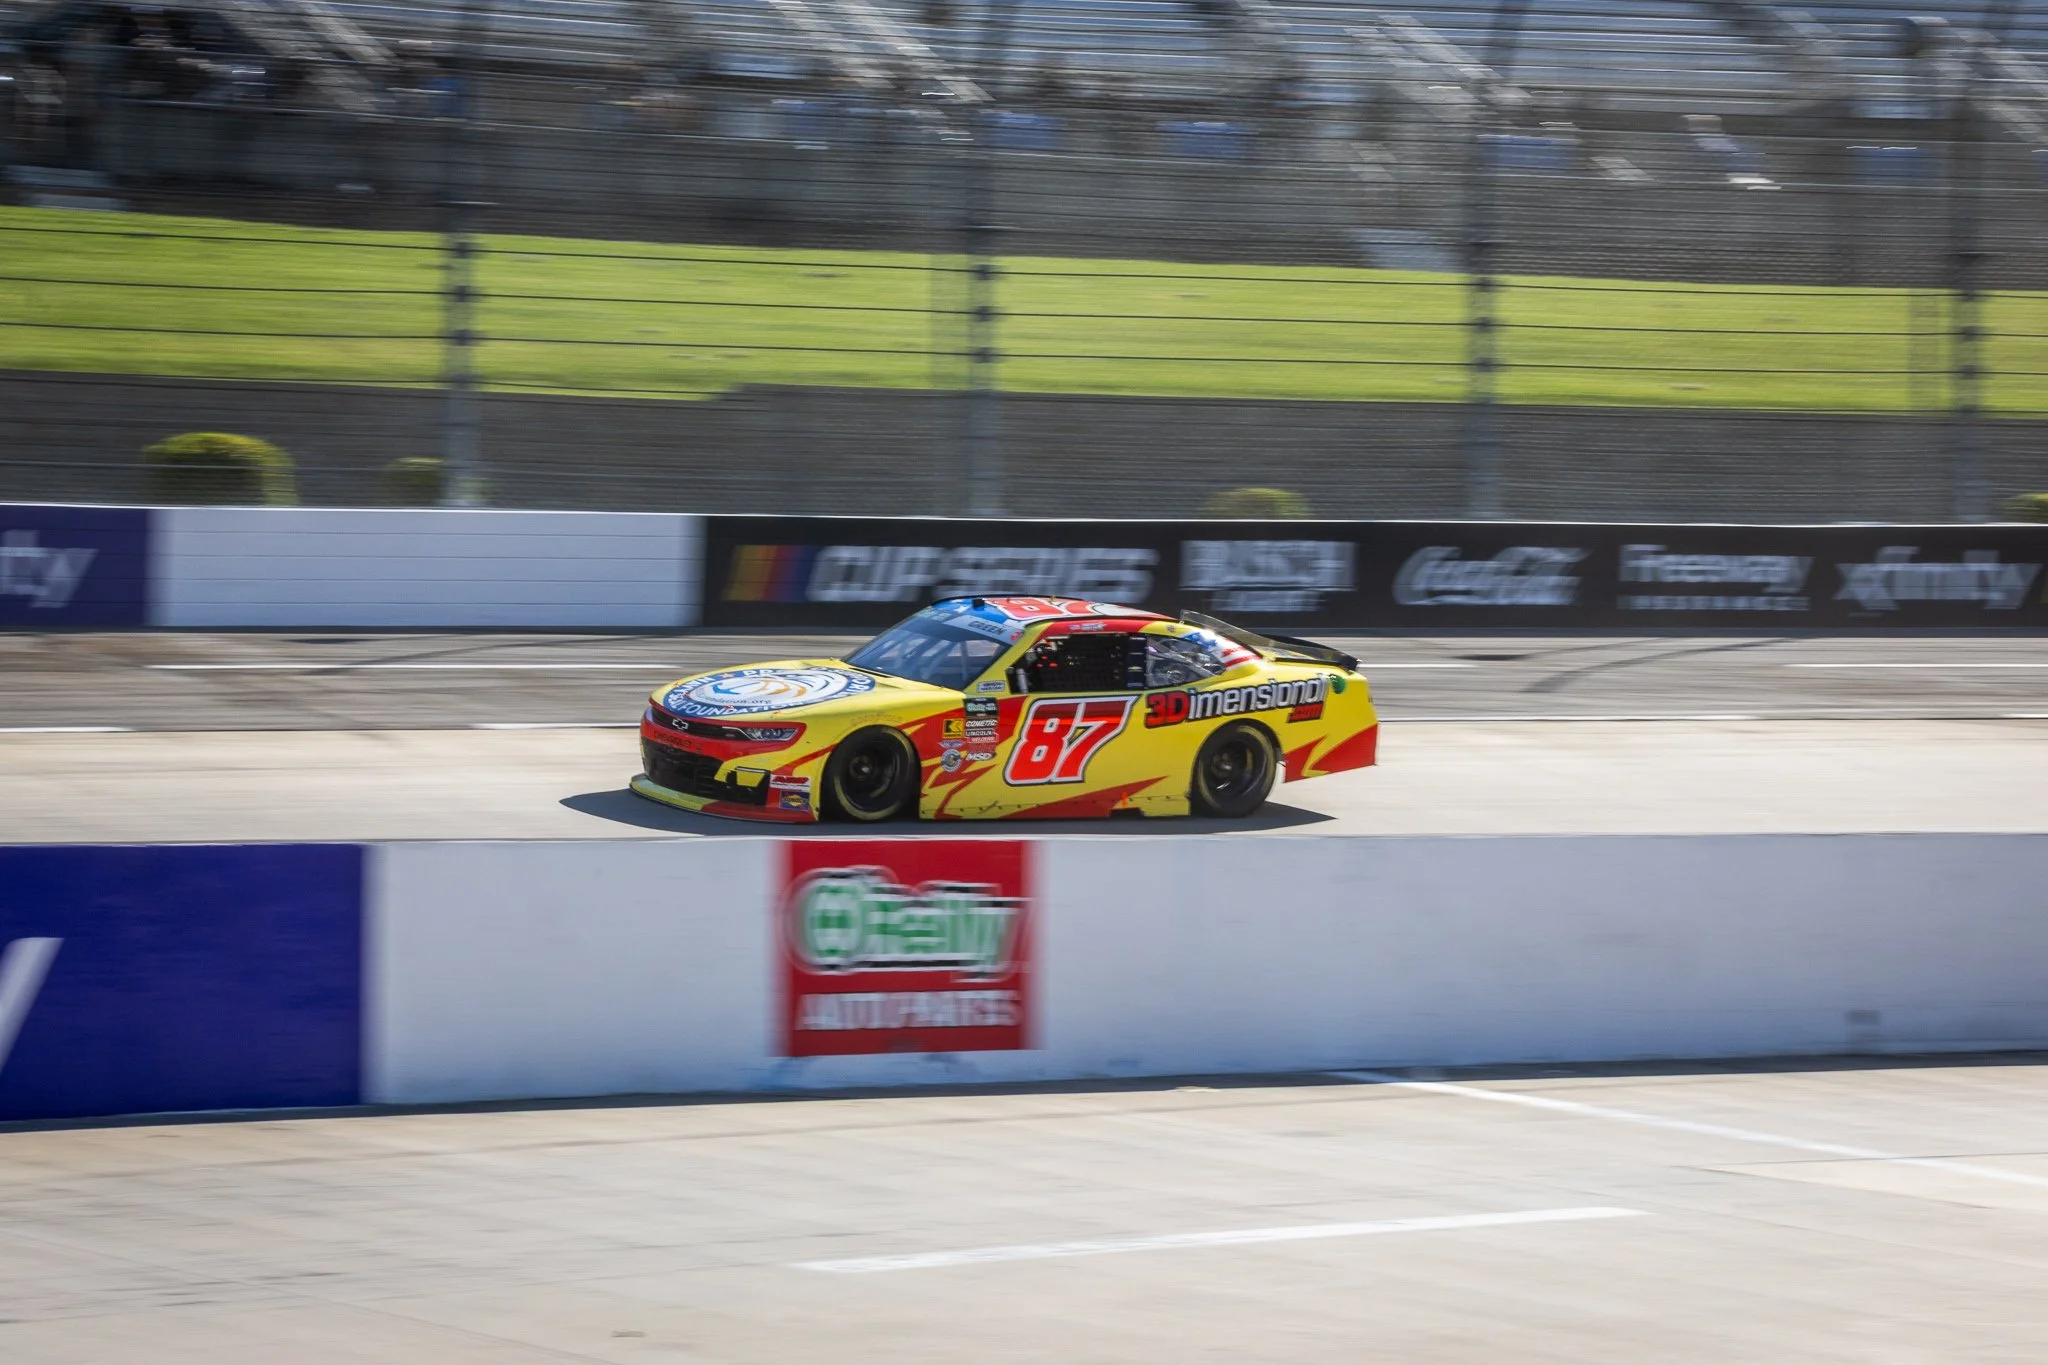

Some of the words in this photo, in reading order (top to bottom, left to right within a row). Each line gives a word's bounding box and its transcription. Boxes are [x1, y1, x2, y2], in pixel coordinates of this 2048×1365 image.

[967, 620, 1006, 635] GREEN
[1146, 674, 1329, 728] 3Dimensional
[1004, 694, 1138, 785] 87
